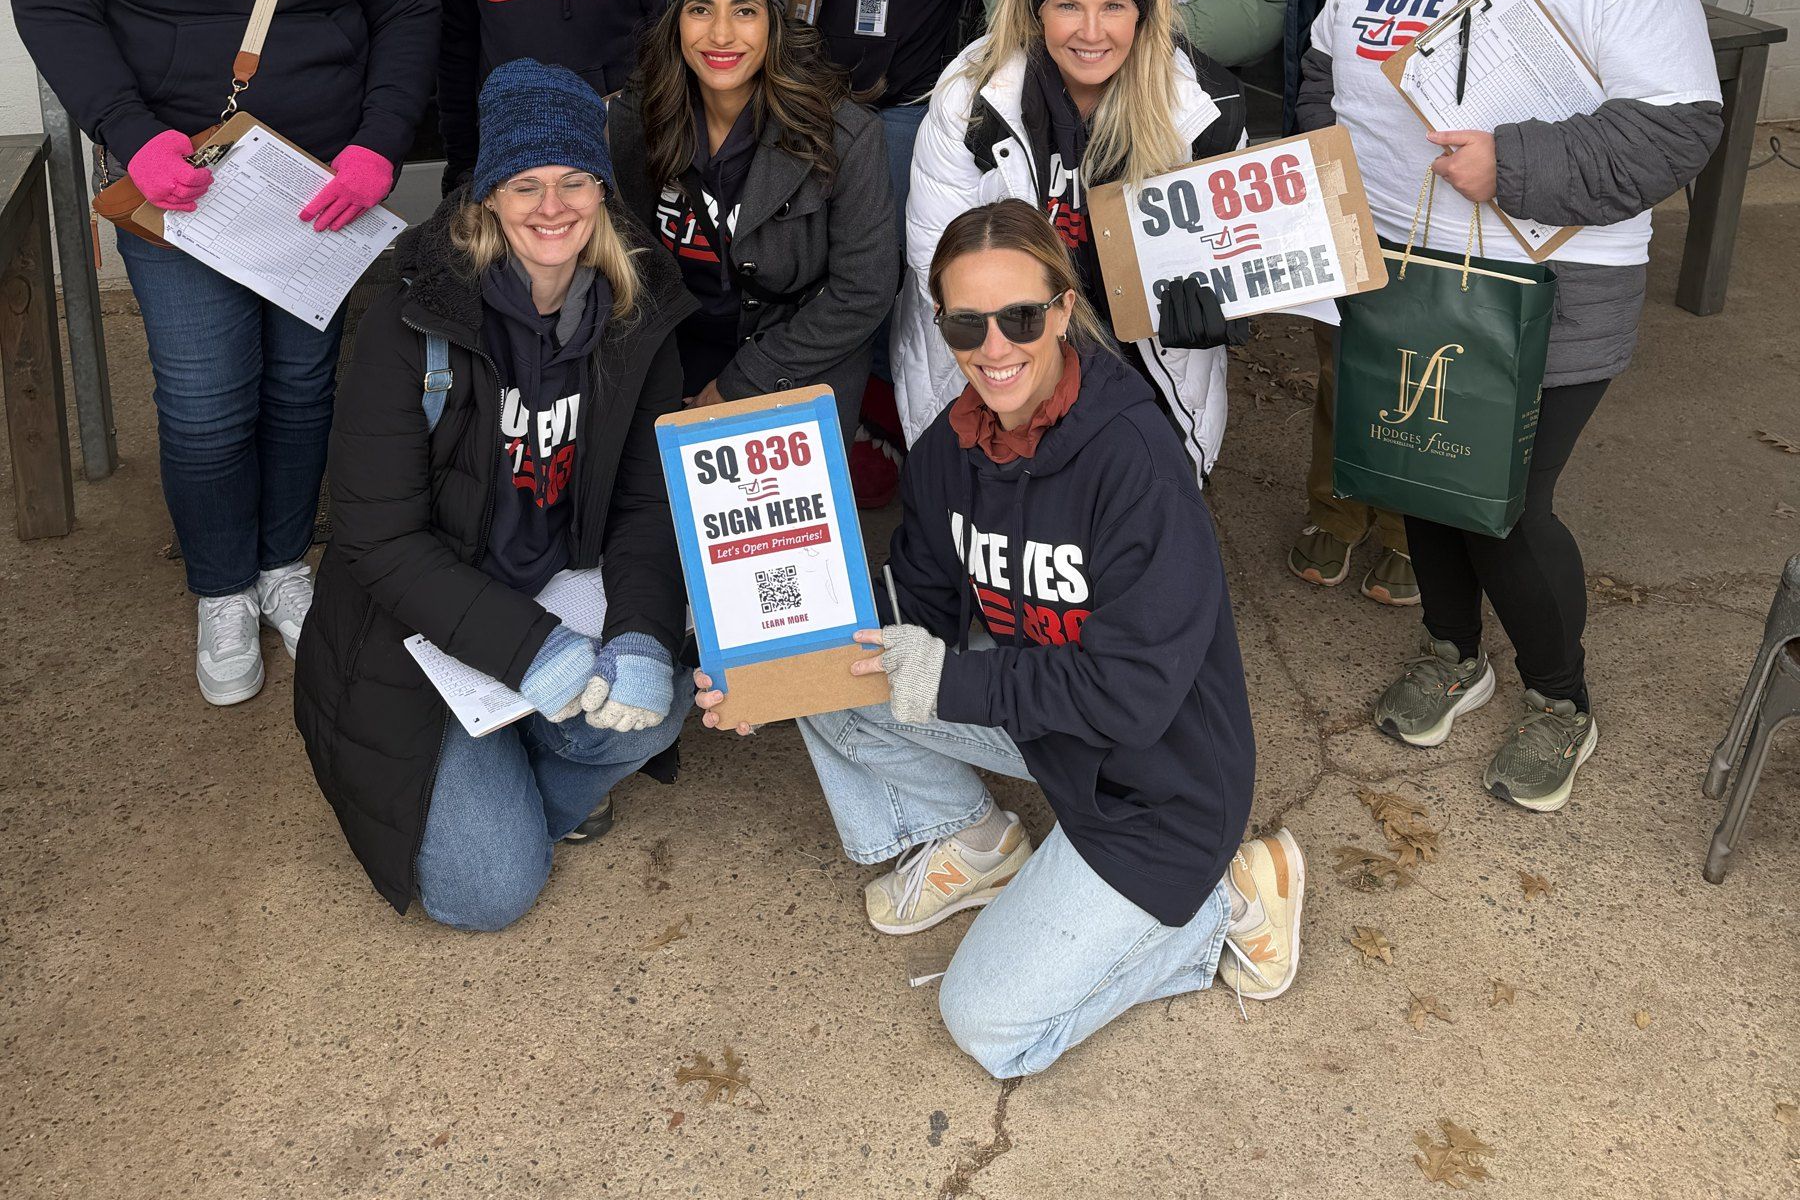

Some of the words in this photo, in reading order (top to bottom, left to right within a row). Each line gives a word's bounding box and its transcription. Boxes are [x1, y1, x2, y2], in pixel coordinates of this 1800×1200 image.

[1138, 179, 1204, 238] SQ
[1207, 153, 1307, 221] 836
[1241, 244, 1335, 299] HERE
[1370, 423, 1421, 445] HODGES
[694, 445, 741, 485] SQ
[744, 431, 812, 476] 836
[702, 505, 763, 540] SIGN
[768, 493, 826, 526] HERE
[717, 545, 740, 559] Let's
[742, 540, 769, 555] Open
[771, 529, 823, 548] Primaries!
[761, 617, 786, 630] LEARN
[787, 613, 810, 625] MORE
[924, 859, 972, 898] N
[1242, 931, 1280, 965] N
